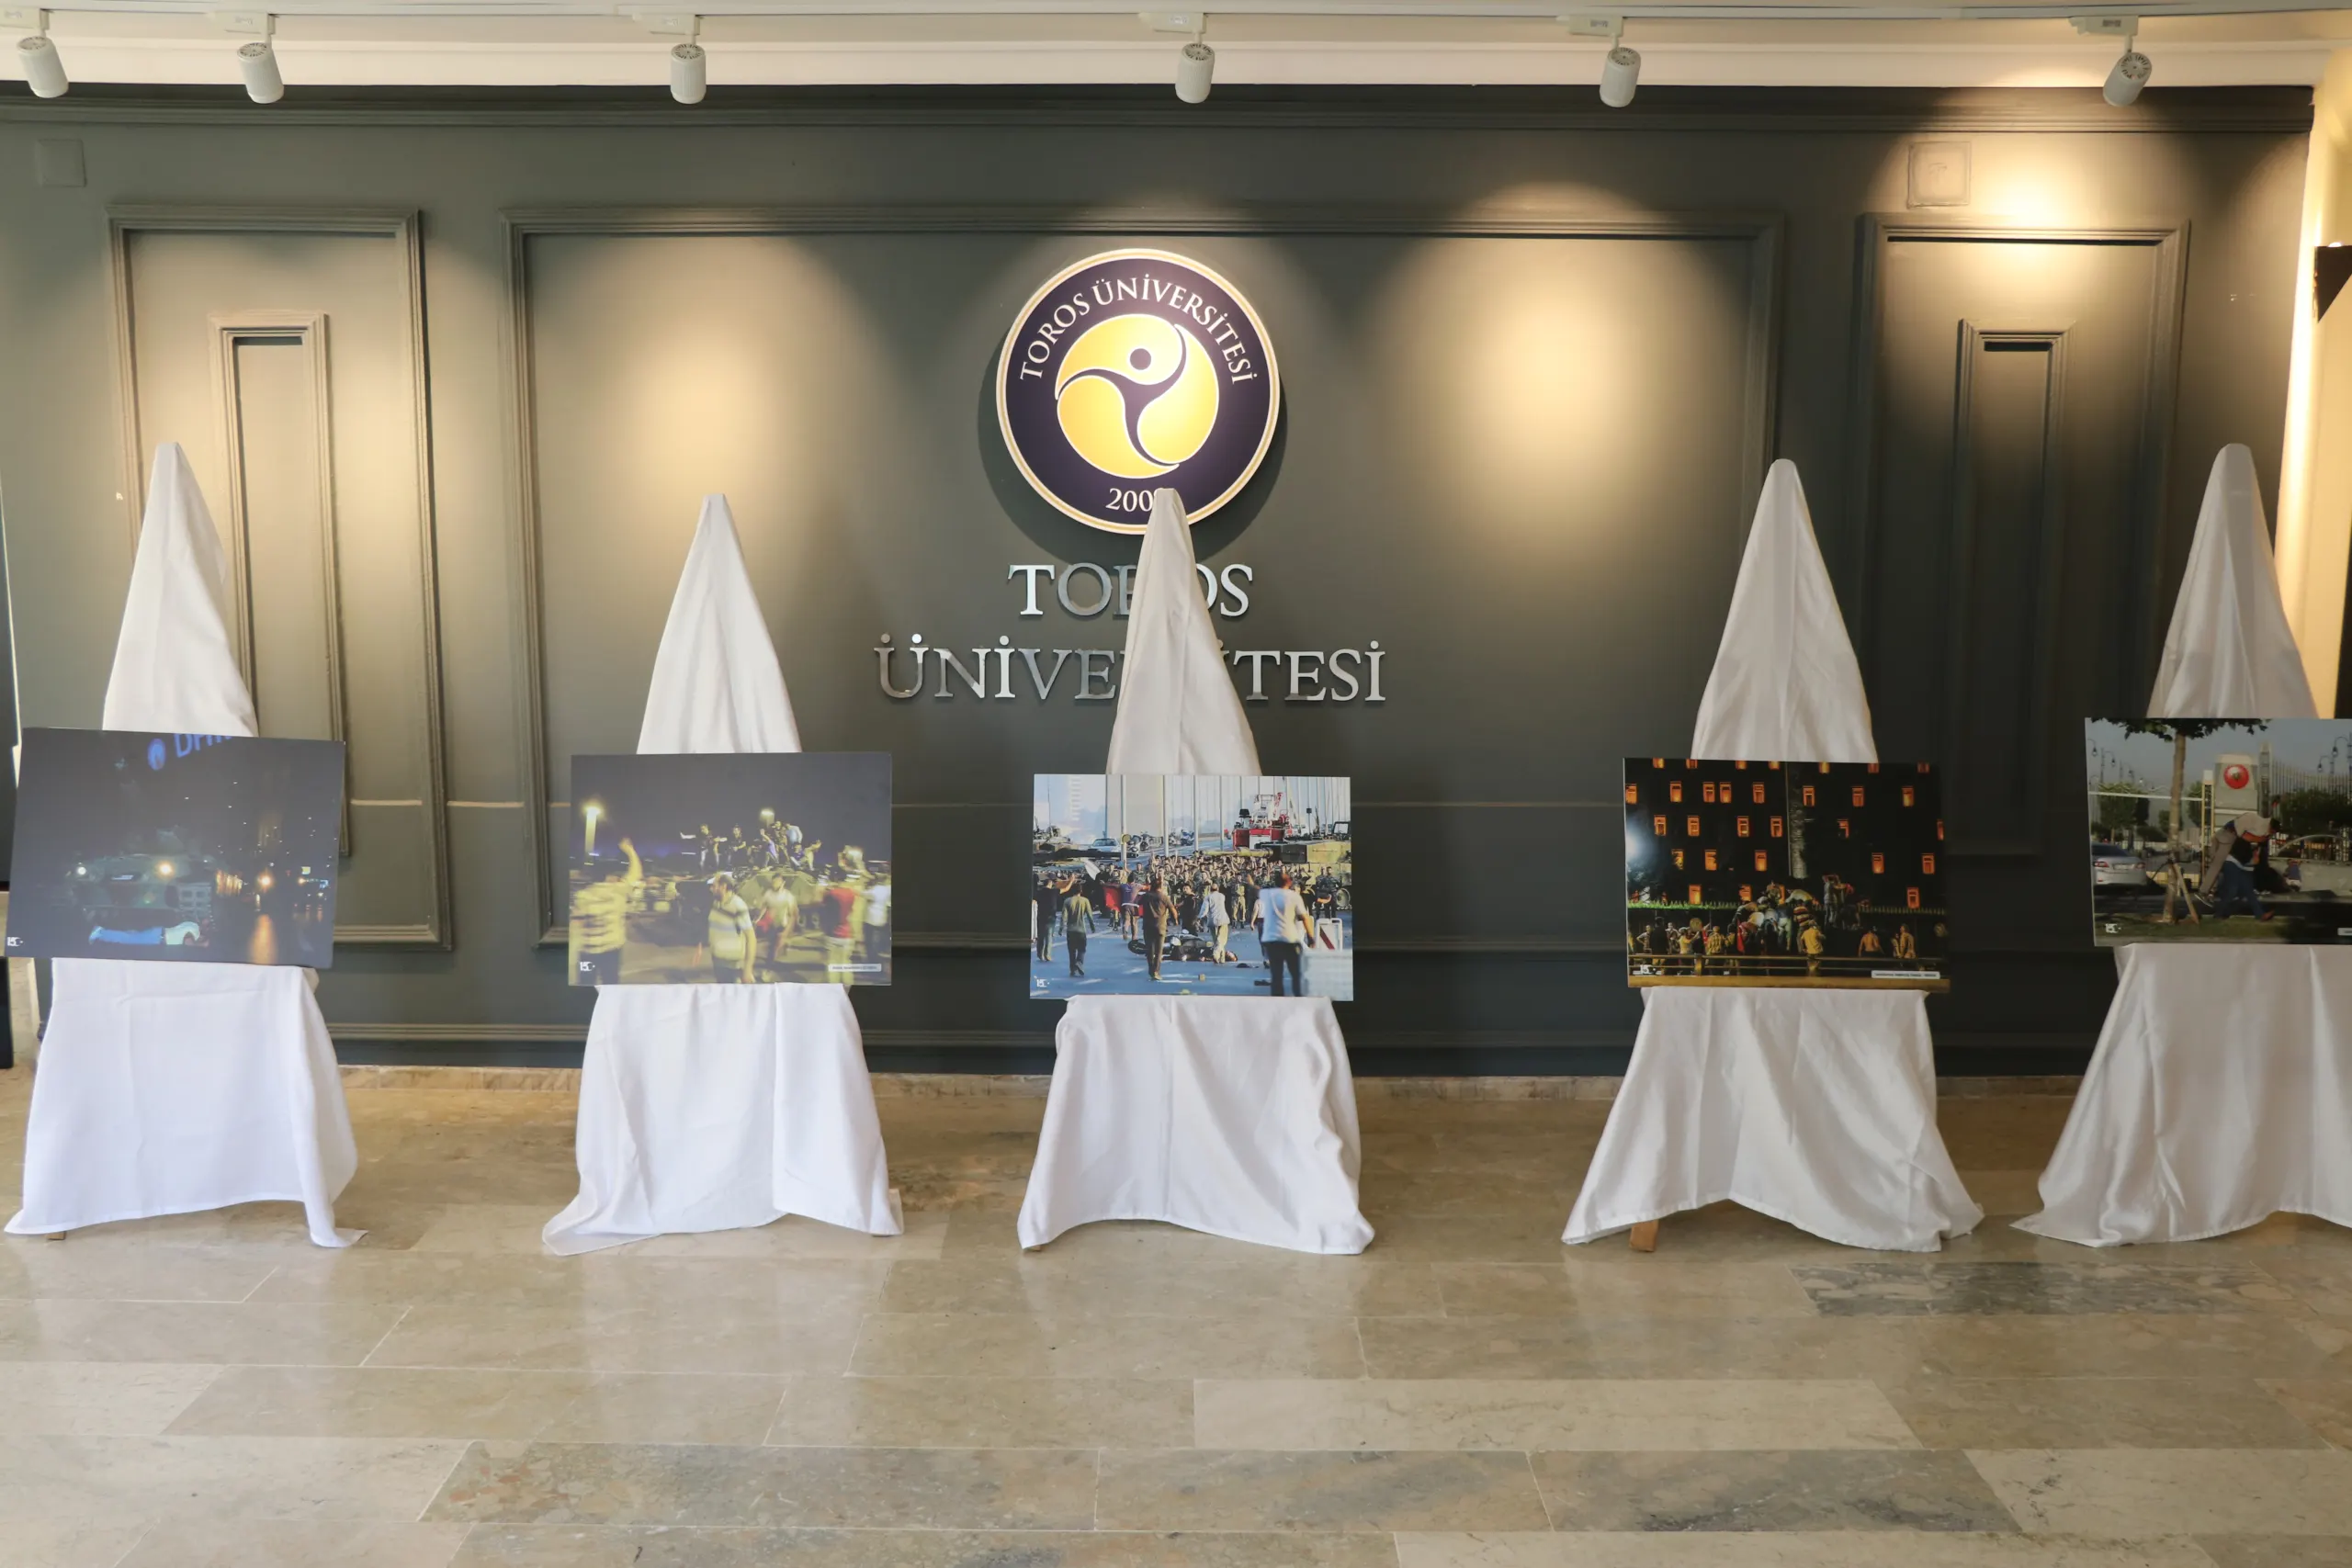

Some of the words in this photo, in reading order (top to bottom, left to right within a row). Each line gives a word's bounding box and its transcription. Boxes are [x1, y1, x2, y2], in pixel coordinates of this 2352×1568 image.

[1020, 292, 1091, 380] TOROS
[1091, 273, 1258, 385] ÜNİVERSİTESİ
[1105, 485, 1157, 513] 200
[874, 634, 1386, 702] ÜNİVETESİ
